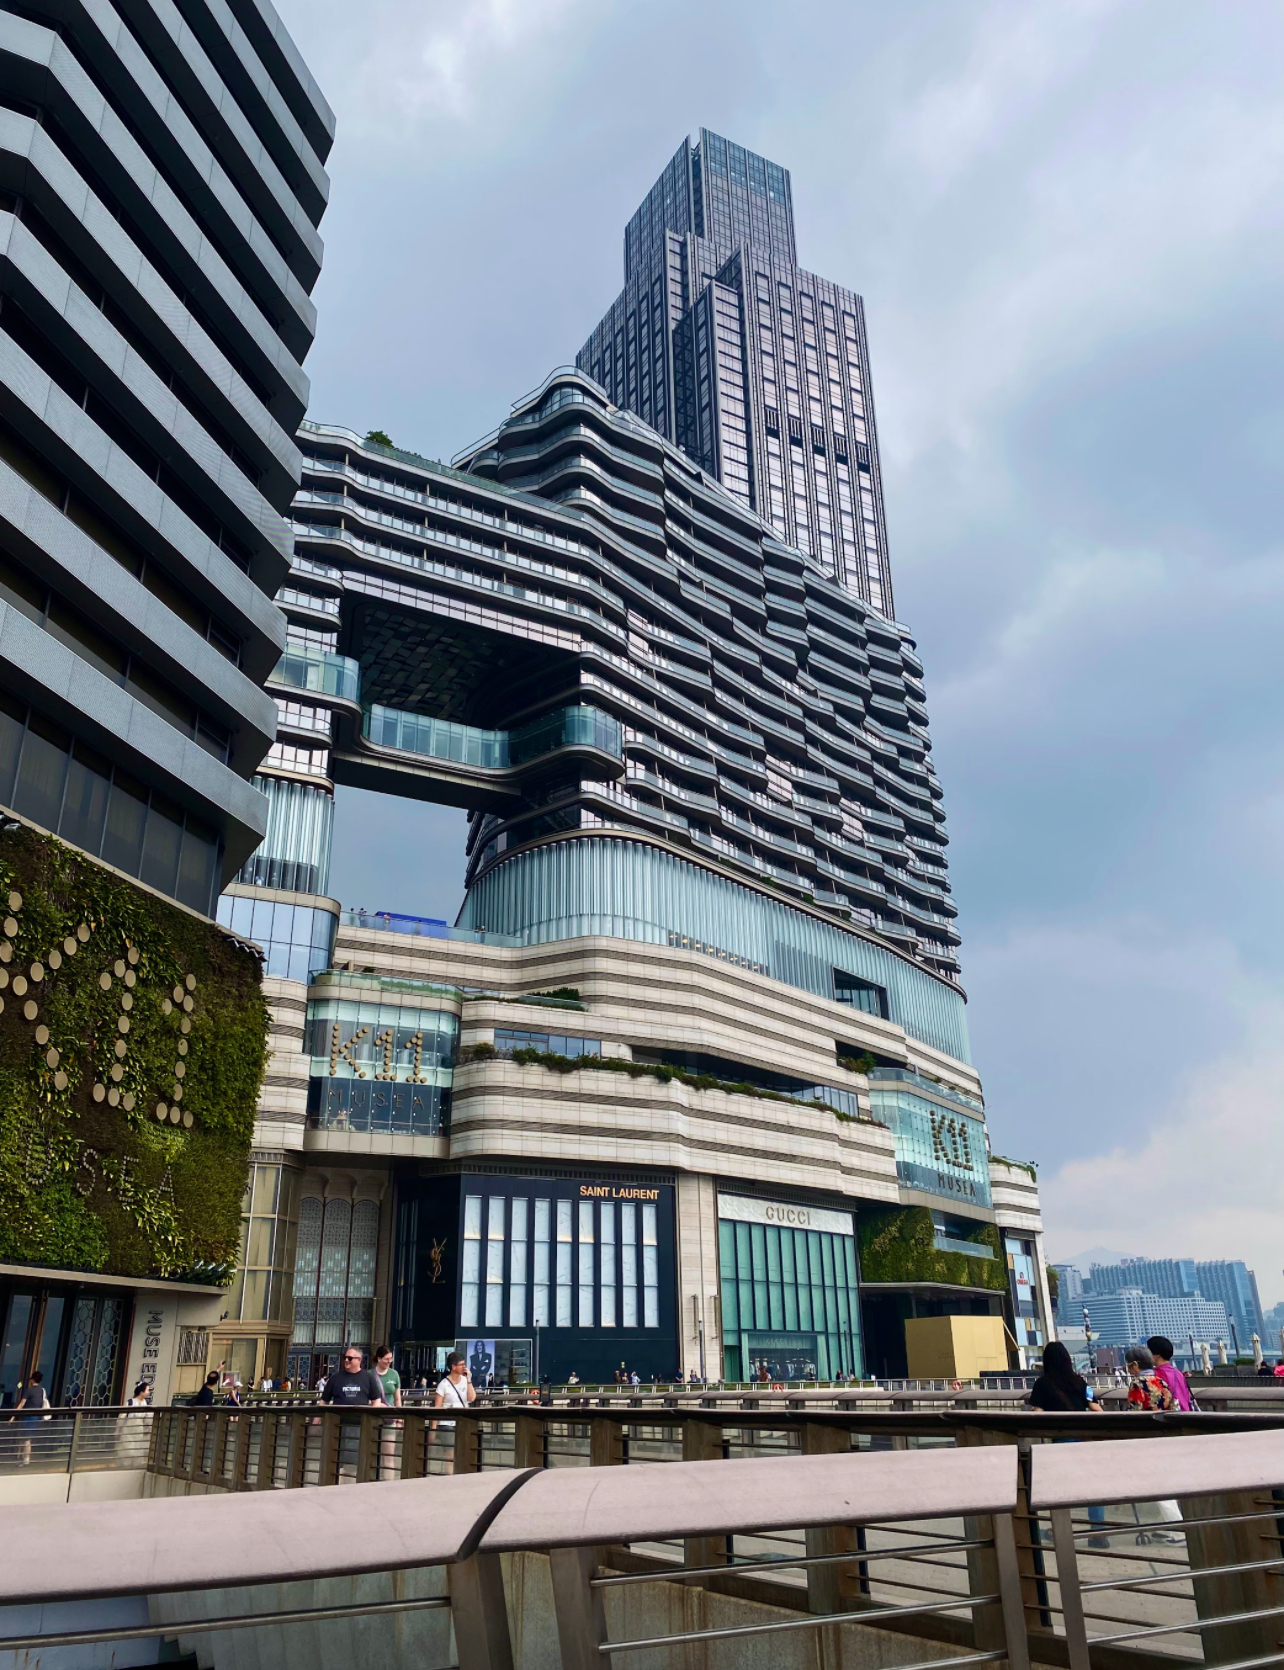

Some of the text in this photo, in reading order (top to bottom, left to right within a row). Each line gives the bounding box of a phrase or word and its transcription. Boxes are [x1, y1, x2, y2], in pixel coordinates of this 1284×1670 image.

[329, 1023, 427, 1084] K11
[327, 1087, 425, 1110] MUSEA
[929, 1109, 974, 1171] K11
[580, 1185, 660, 1200] SAINT LAURENT
[937, 1173, 976, 1198] MUSEA
[765, 1206, 811, 1226] GUCCI
[143, 1310, 163, 1359] MUSE
